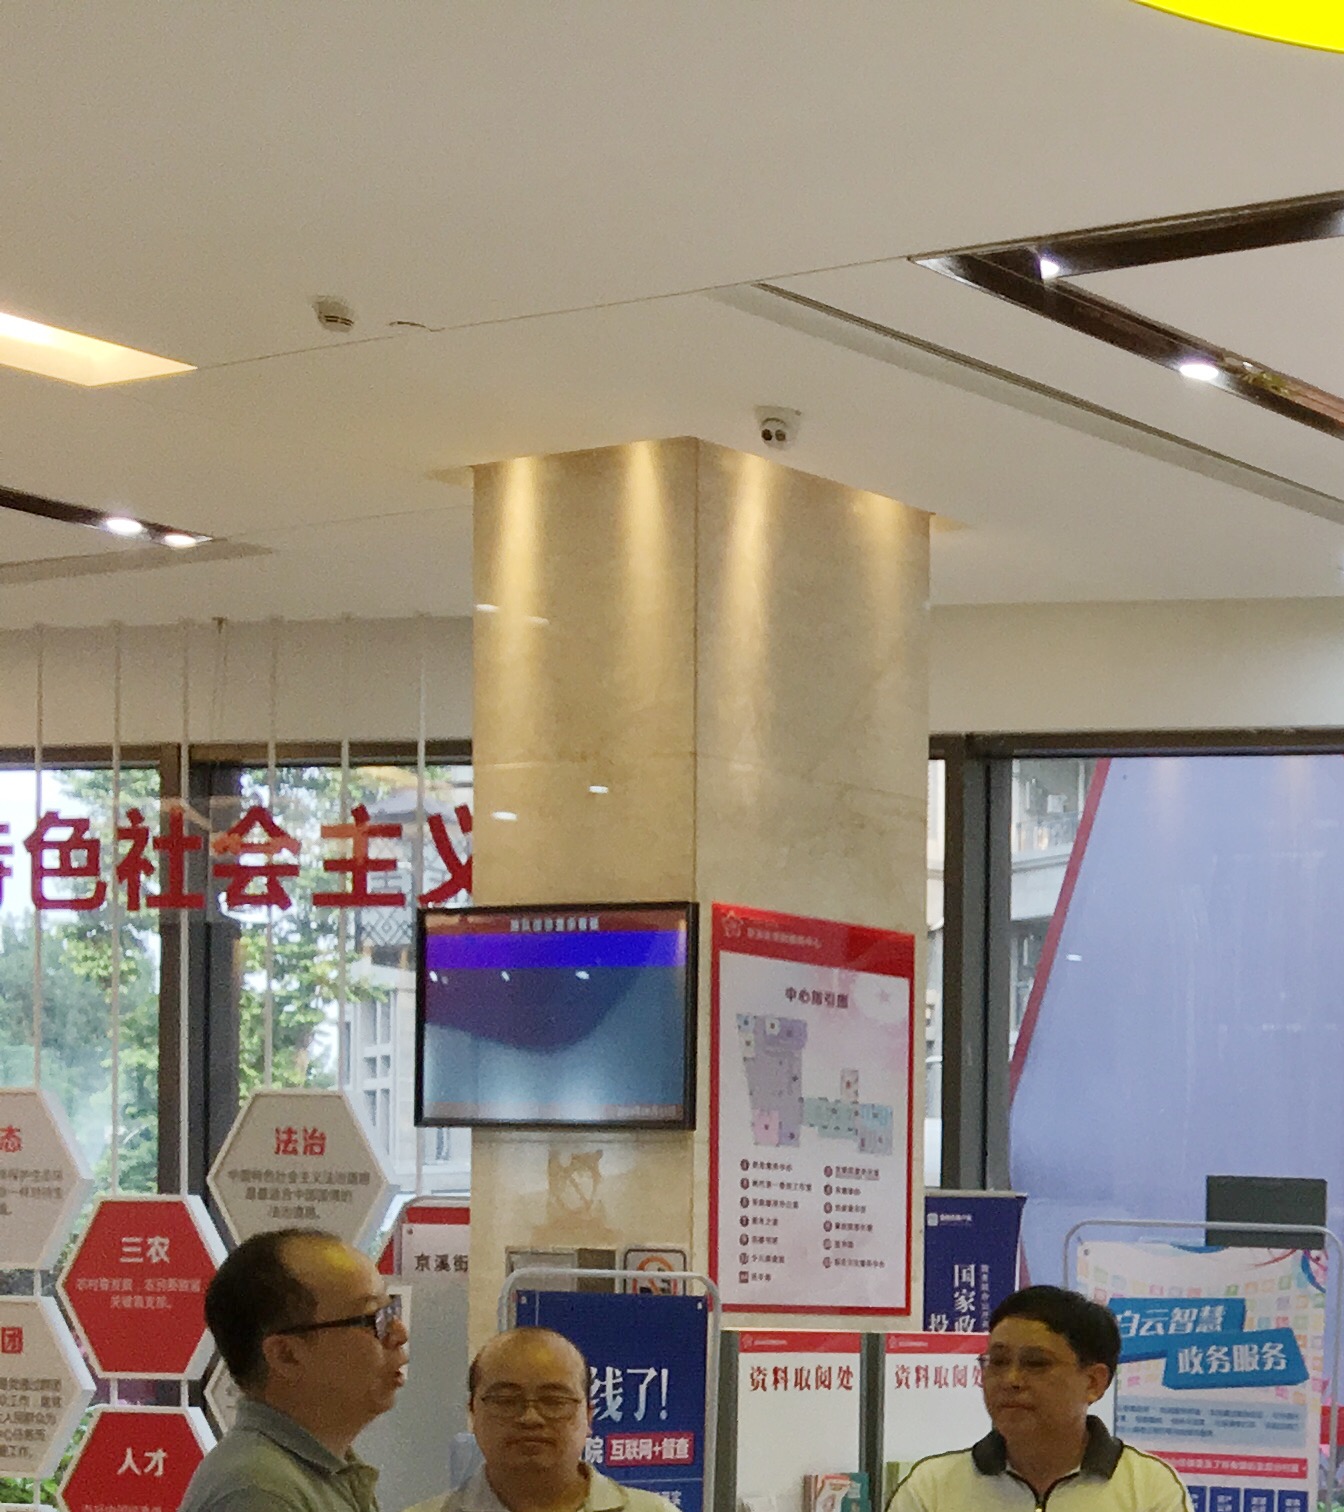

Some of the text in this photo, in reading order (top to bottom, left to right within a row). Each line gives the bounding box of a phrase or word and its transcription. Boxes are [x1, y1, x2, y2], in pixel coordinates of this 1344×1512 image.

[0, 804, 473, 911] 色社会主义
[275, 1126, 327, 1156] 法治
[119, 1236, 170, 1264] 三农
[1117, 1305, 1226, 1337] 白云智慧
[1177, 1342, 1287, 1375] 政务服务
[749, 1365, 853, 1392] 资料取阅处
[117, 1447, 168, 1477] 人才
